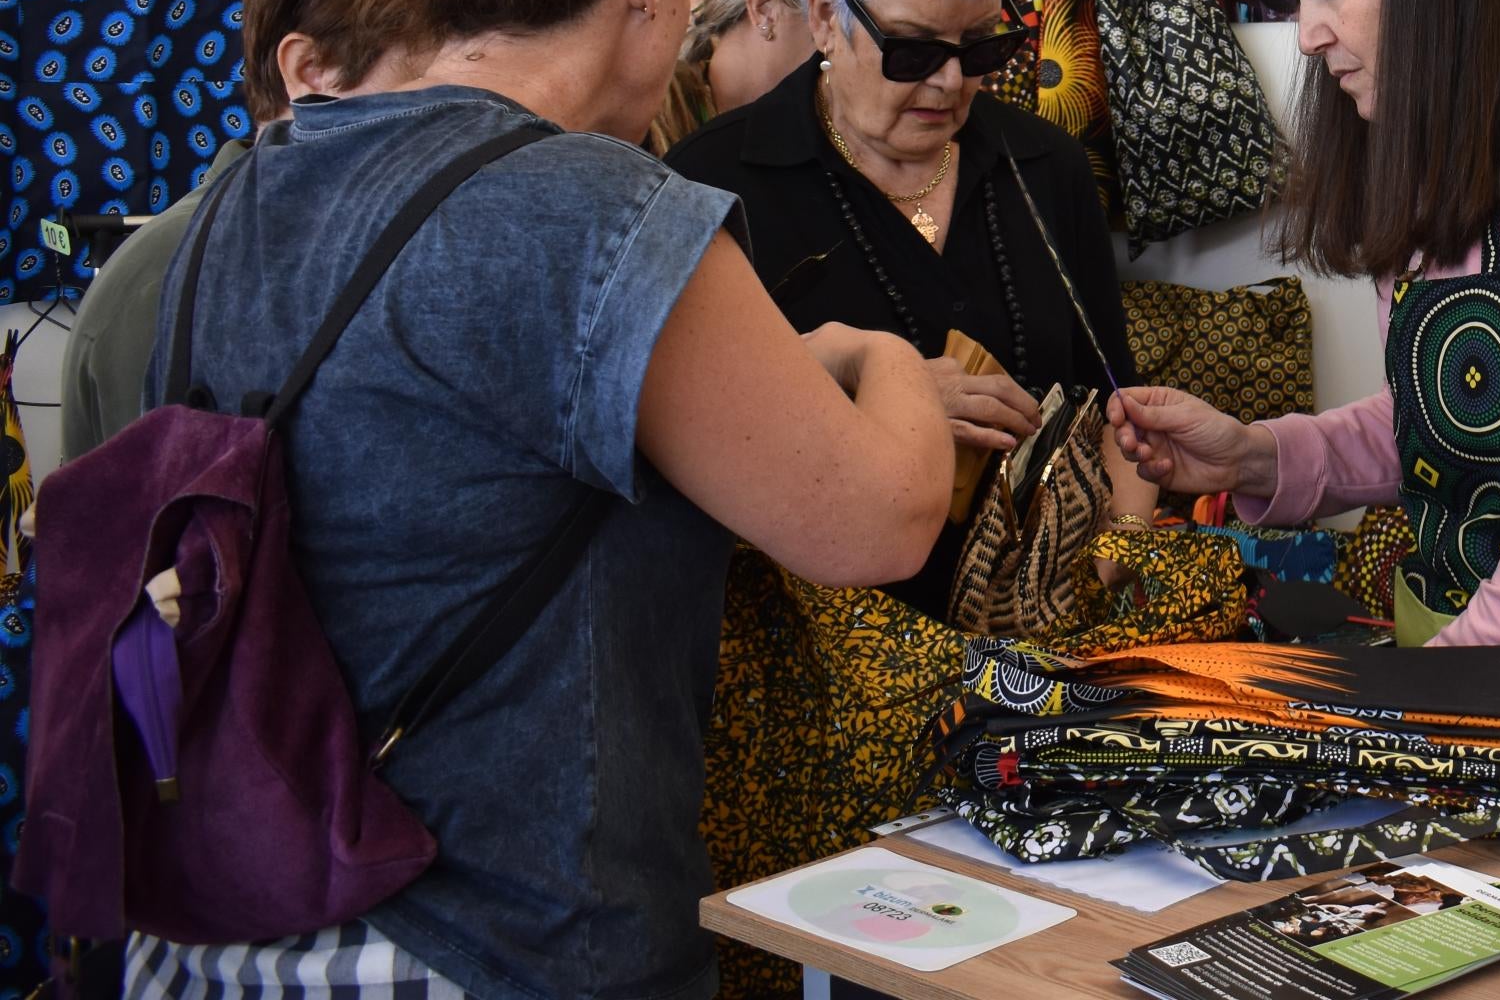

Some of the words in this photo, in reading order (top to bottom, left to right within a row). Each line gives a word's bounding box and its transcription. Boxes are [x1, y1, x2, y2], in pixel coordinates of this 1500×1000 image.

[45, 226, 57, 246] 10
[58, 230, 66, 249] €
[863, 902, 912, 921] 08723
